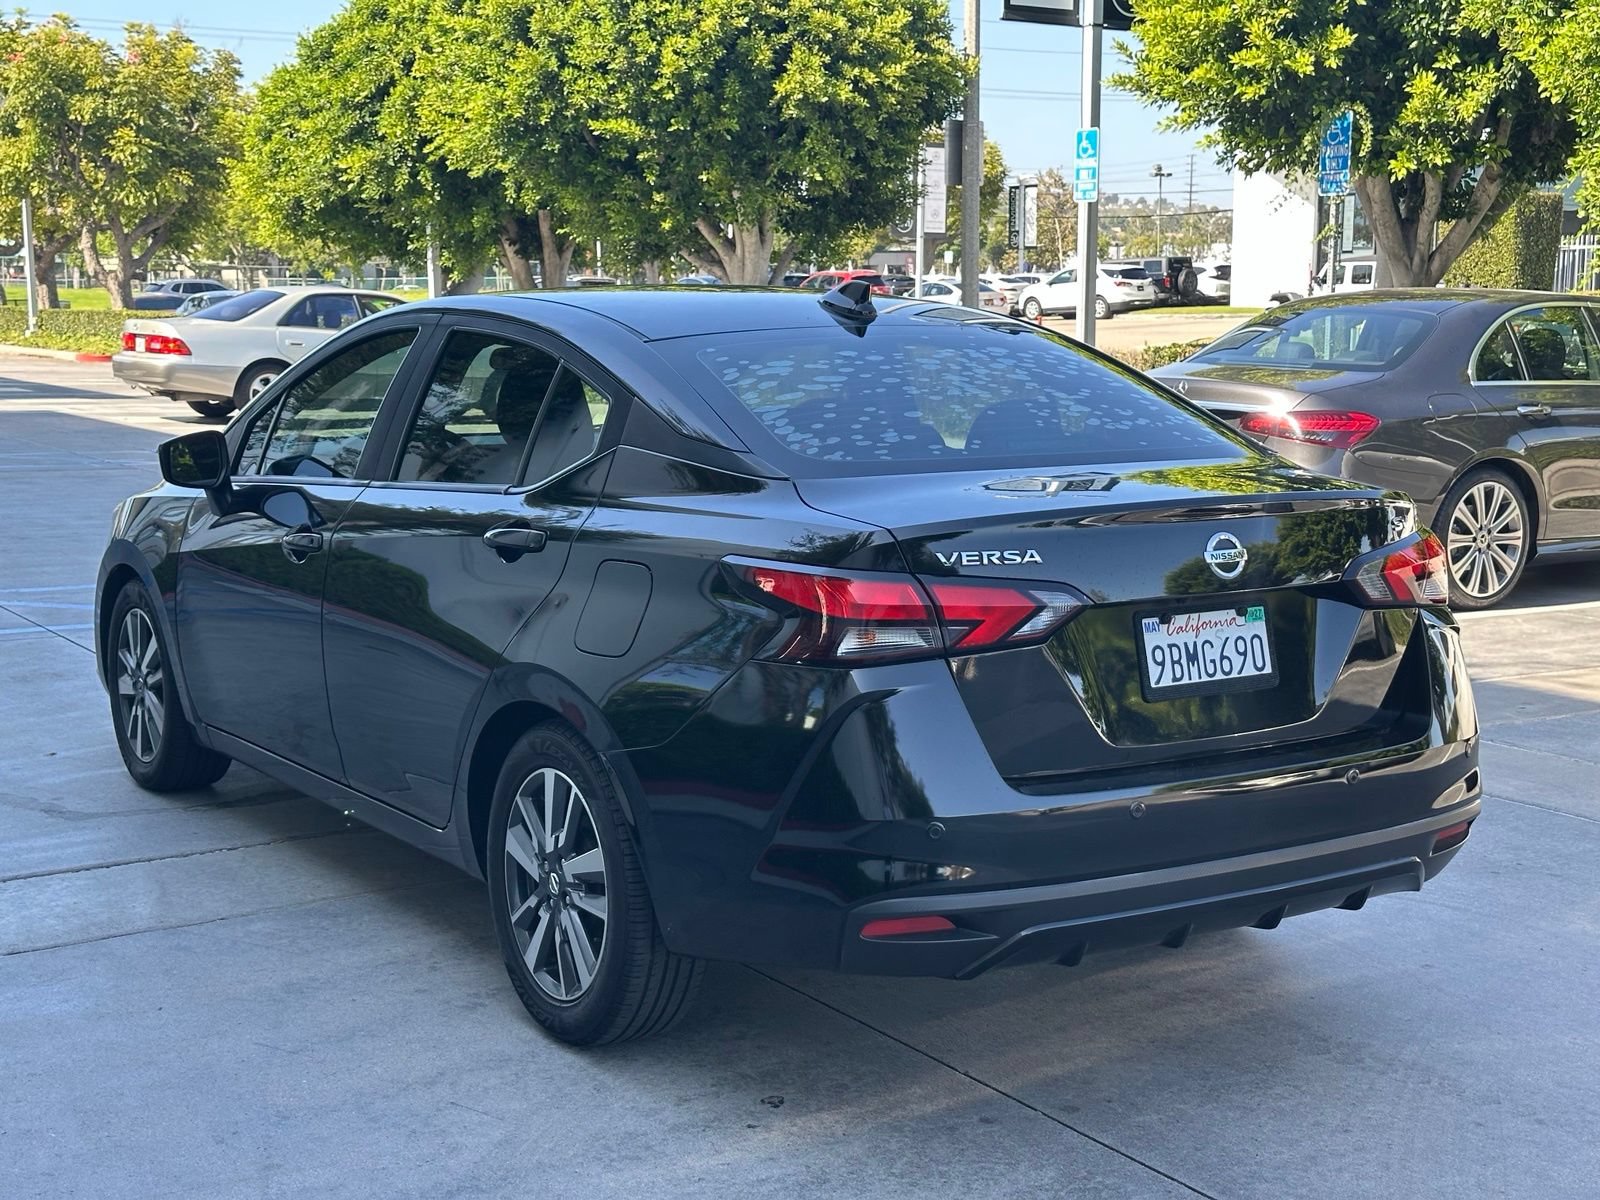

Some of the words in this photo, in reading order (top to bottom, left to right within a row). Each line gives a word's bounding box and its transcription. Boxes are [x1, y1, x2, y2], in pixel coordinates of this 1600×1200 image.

[935, 549, 1044, 567] VERSA
[1210, 550, 1245, 562] NISSAN
[1144, 622, 1160, 633] MAY
[1166, 611, 1245, 639] California
[1151, 634, 1266, 685] 9BMG690
